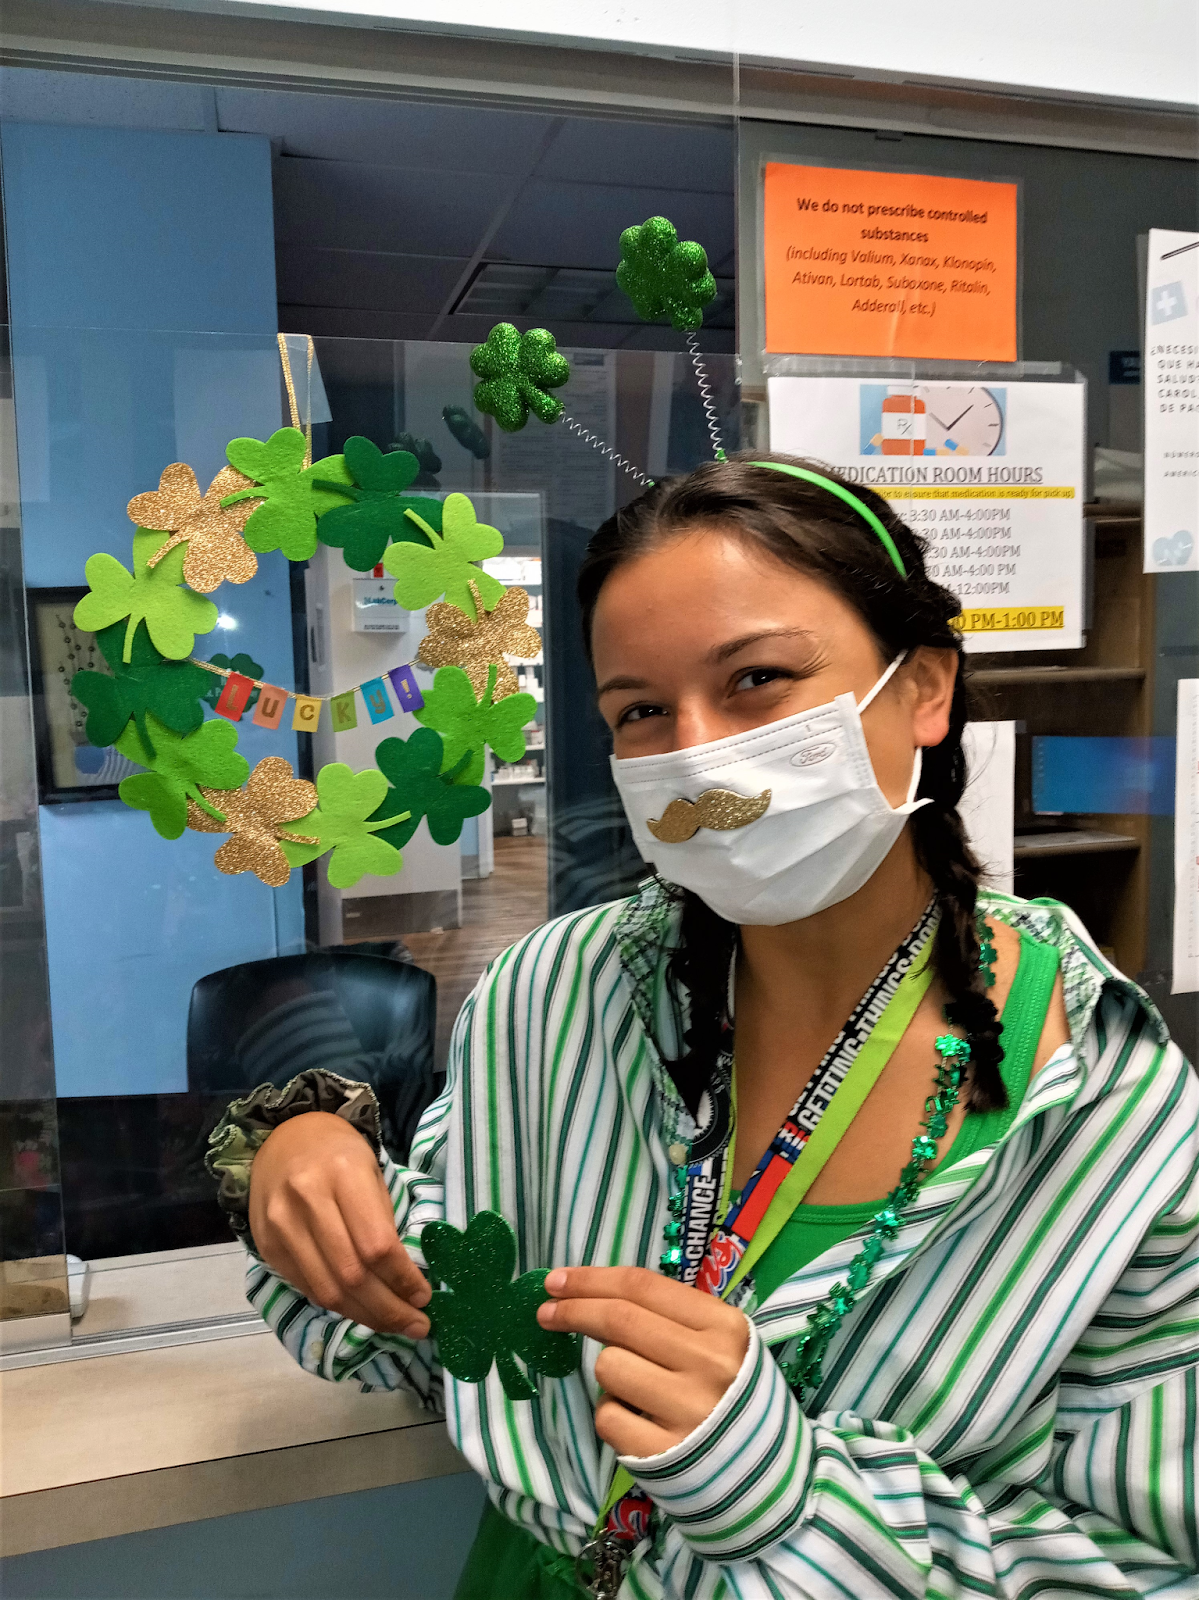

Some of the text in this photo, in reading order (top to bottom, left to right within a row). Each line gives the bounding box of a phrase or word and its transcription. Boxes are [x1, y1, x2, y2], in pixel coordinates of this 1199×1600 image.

[797, 198, 988, 224] We do not prescribe controlled
[861, 227, 929, 243] substances
[786, 246, 997, 274] (including Valium, Xanax, Klonopin,
[792, 271, 992, 296] Ativan, Lortab, Suboxone, Ritalin,
[852, 298, 937, 317] Adderall, etc.)
[1158, 359, 1182, 370] QUE
[1160, 403, 1175, 413] DE
[933, 466, 982, 483] ROOM
[987, 466, 1043, 483] HOURS
[939, 507, 1011, 522] AM-4:00PM
[940, 526, 1012, 541] AM-4:00PM
[949, 544, 1021, 559] AM-4:00PM
[942, 563, 995, 578] AM-4:00
[997, 562, 1017, 577] PM
[970, 611, 1036, 629] PM-1:00
[1040, 609, 1064, 627] PM
